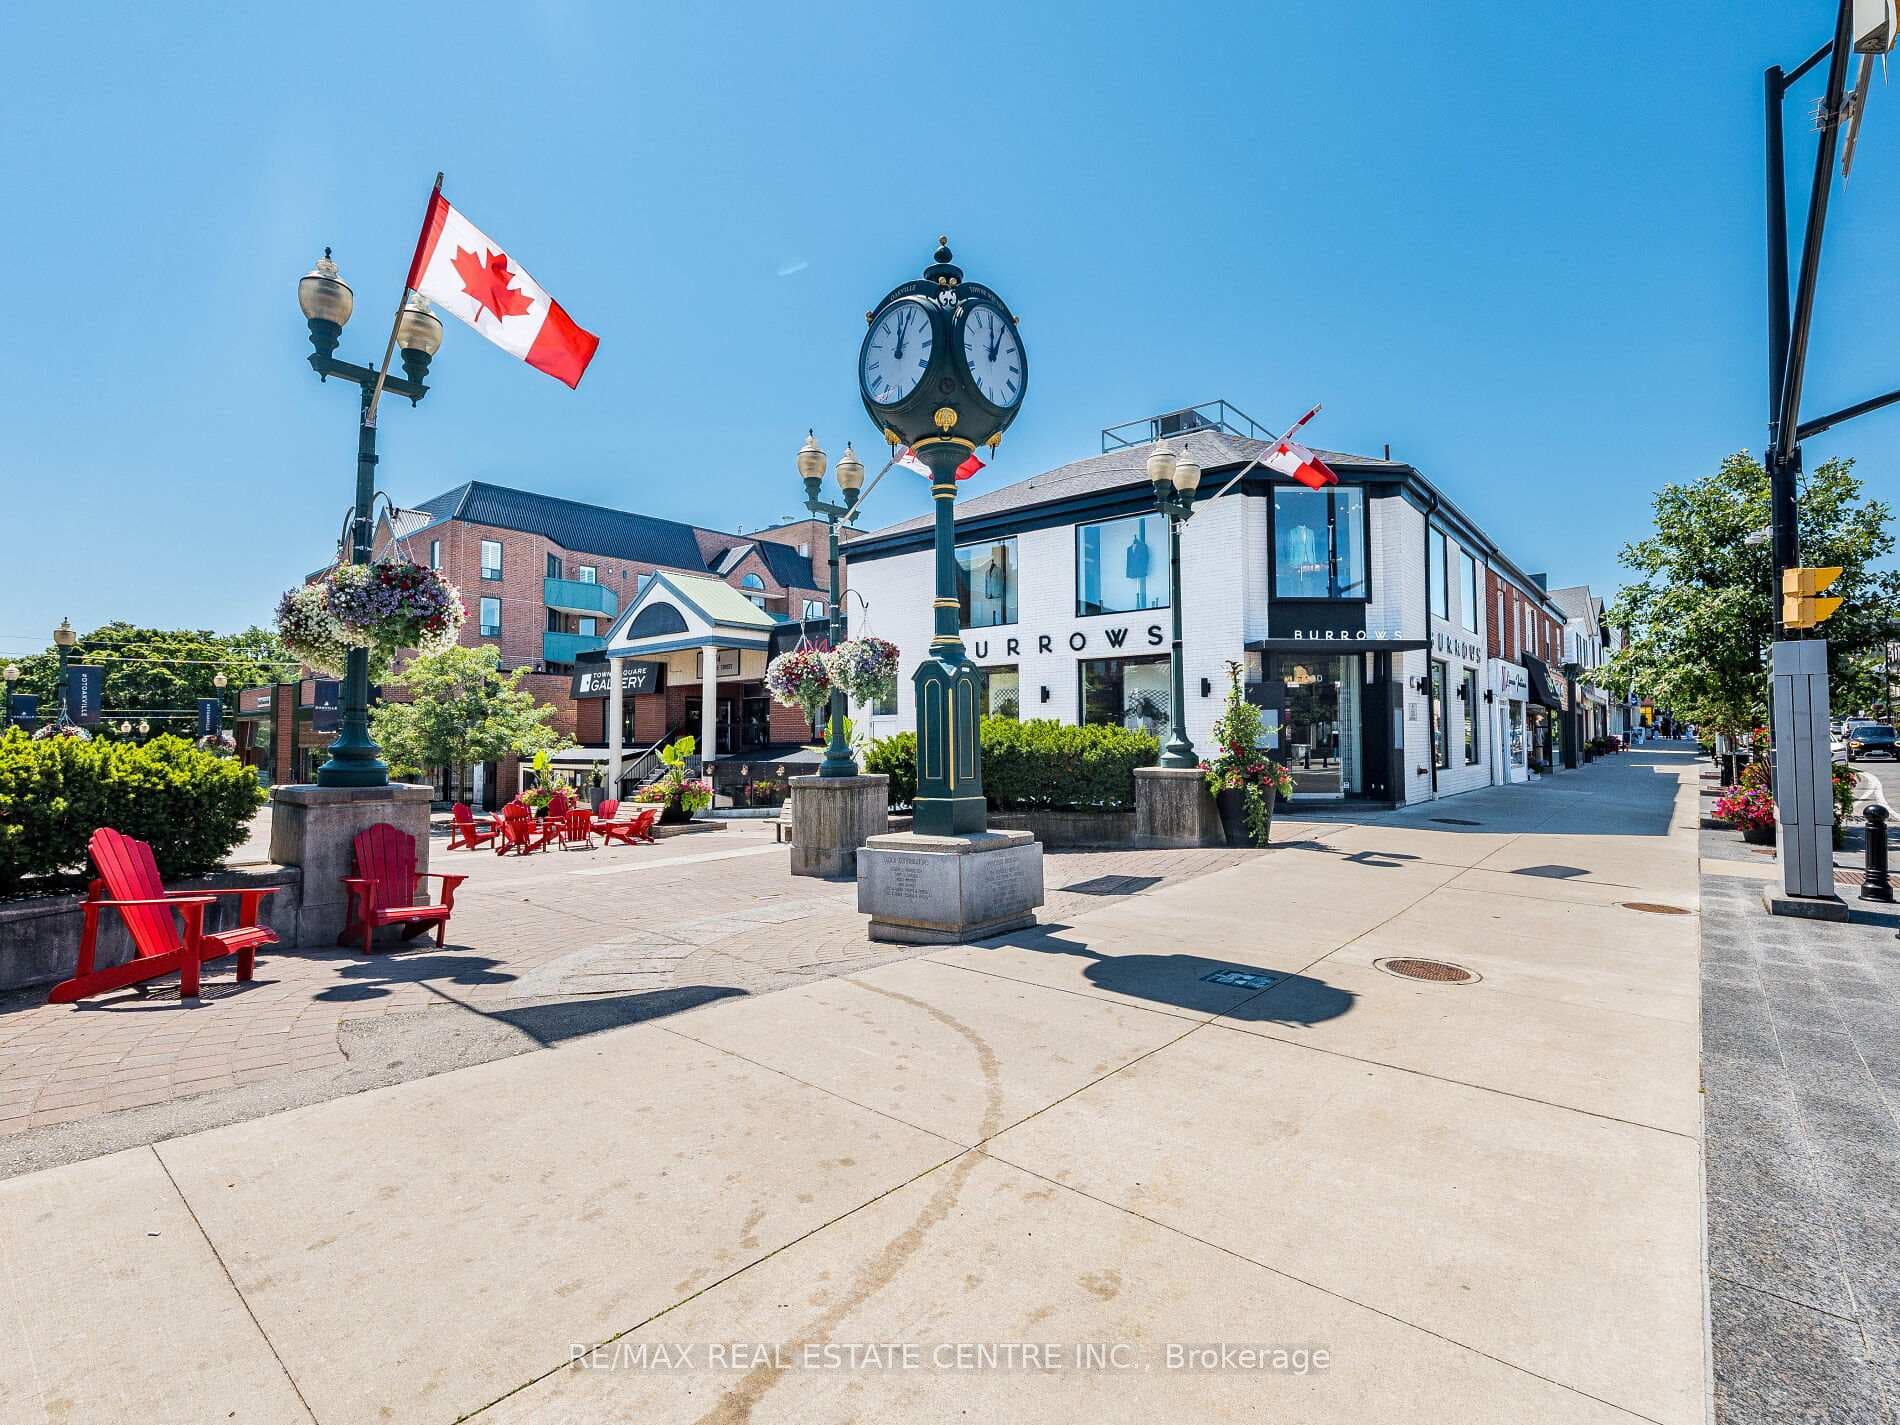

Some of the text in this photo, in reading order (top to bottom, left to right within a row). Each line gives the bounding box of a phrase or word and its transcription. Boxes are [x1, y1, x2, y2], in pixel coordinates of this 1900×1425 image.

[1294, 629, 1403, 640] BURROWS
[975, 625, 1164, 659] URROWS
[622, 667, 648, 676] QUARE
[591, 675, 646, 692] GALERY
